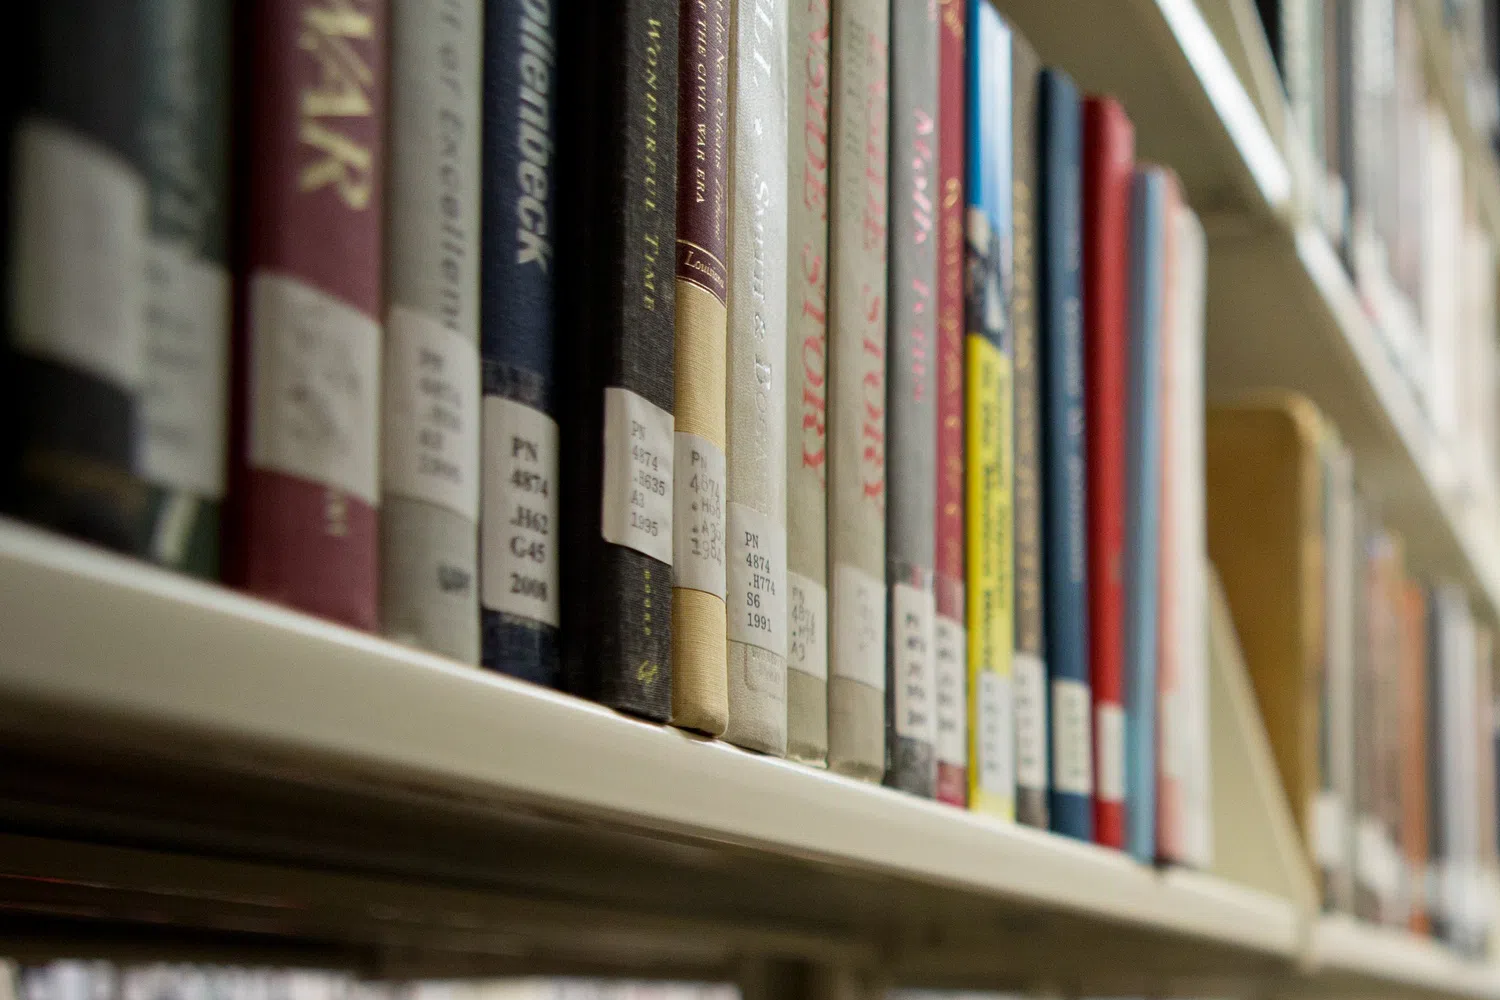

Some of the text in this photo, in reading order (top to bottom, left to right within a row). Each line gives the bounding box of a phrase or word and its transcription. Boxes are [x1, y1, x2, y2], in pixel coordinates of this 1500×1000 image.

[696, 19, 707, 58] THE
[714, 49, 726, 90] New
[696, 63, 707, 112] CIVIL
[515, 0, 554, 273] ollenbeck
[695, 122, 706, 161] WAR
[714, 97, 725, 173] Orleans
[643, 18, 662, 312] WONDERFUL TIME
[695, 169, 706, 204] ERA
[801, 244, 829, 490] STORY
[511, 436, 538, 463] PN
[631, 446, 659, 472] 4874
[690, 451, 707, 469] PN
[511, 469, 549, 499] 4874
[510, 536, 546, 563] G45
[744, 532, 759, 549] PN
[746, 553, 771, 574] 4874
[747, 574, 776, 596] .H774
[746, 592, 761, 609] S6
[747, 613, 773, 633] 1991
